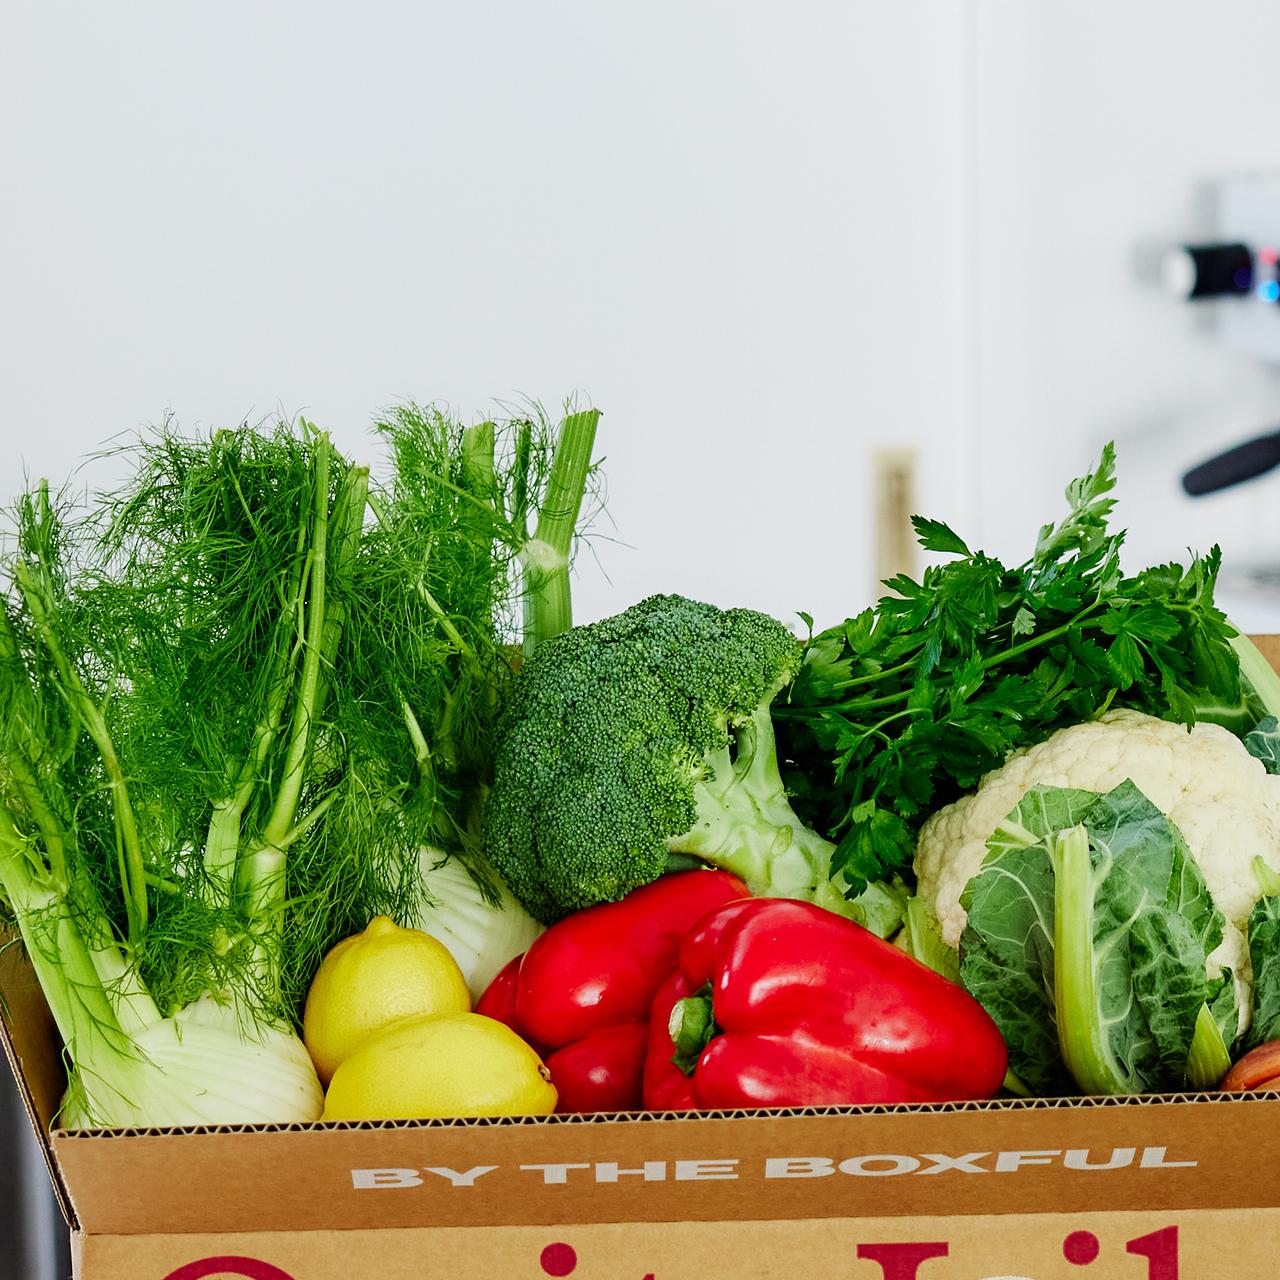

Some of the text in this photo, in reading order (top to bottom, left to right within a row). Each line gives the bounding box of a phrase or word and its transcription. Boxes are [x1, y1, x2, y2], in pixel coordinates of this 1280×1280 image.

[350, 1147, 1198, 1189] BY THE BOXFUL
